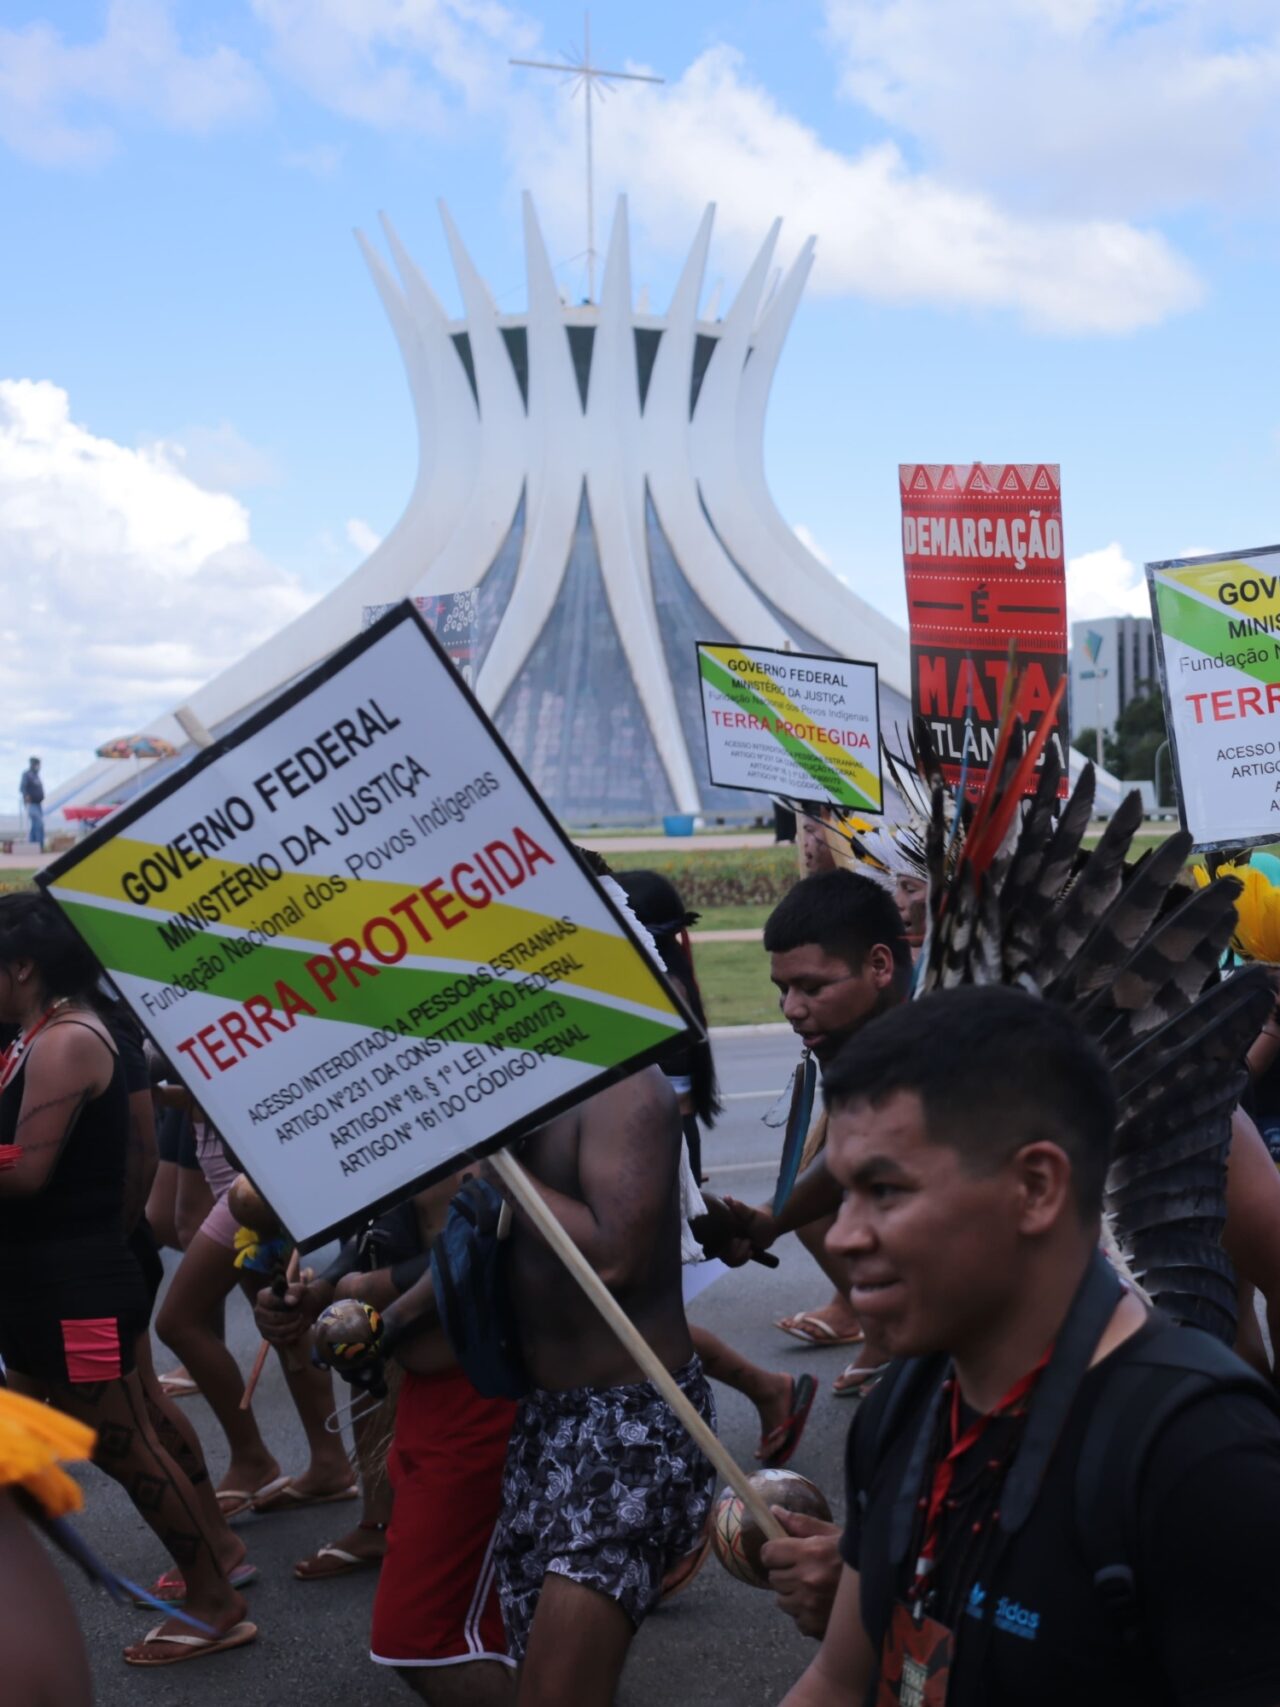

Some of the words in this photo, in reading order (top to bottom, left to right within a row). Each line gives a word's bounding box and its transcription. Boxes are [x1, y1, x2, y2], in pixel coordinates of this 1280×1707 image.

[903, 509, 1061, 570] DEMARCAÇÃO
[971, 583, 989, 623] É
[727, 659, 787, 679] GOVERNO
[789, 668, 849, 688] FEDERAL
[731, 679, 786, 696] MINISTÉRIO
[787, 687, 801, 699] DA
[803, 690, 846, 706] JUSTIÇA
[918, 655, 1059, 726] MATA
[1179, 647, 1269, 673] Fundação
[712, 710, 771, 731] TERRA
[775, 720, 871, 750] PROTEGIDA
[801, 704, 826, 717] Povos
[1216, 742, 1275, 761] ACESSO
[121, 796, 254, 906] GOVERNO
[252, 698, 401, 812] FEDERAL
[156, 853, 283, 951] MINISTÉRIO
[280, 825, 331, 866] DA
[331, 755, 431, 836] JUSTIÇA
[140, 953, 225, 1017] Fundação
[220, 897, 305, 965] Nacional
[304, 874, 347, 911] dos
[344, 828, 417, 882] Povos
[410, 771, 500, 837] Indígenas
[176, 979, 318, 1081] TERRA
[305, 826, 555, 1003] PROTEGIDA
[248, 1082, 304, 1126] ACESSO
[301, 1025, 398, 1093] INTERDITADO
[395, 1018, 411, 1037] A
[408, 966, 493, 1029] PESSOAS
[488, 915, 578, 978] ESTRANHAS
[274, 1102, 330, 1145] ARTIGO
[371, 1064, 399, 1087] DA
[395, 990, 517, 1072] CONSTITUIÇÃO
[513, 953, 584, 1002] FEDERAL
[328, 1105, 388, 1150] ARTIGO
[423, 1077, 442, 1097] §
[453, 1047, 487, 1075] LEI
[338, 1132, 400, 1177] ARTIGO
[415, 1107, 443, 1133] 161
[439, 1096, 467, 1119] DO
[463, 1050, 538, 1104] CÓDIGO
[533, 1023, 591, 1063] PENAL
